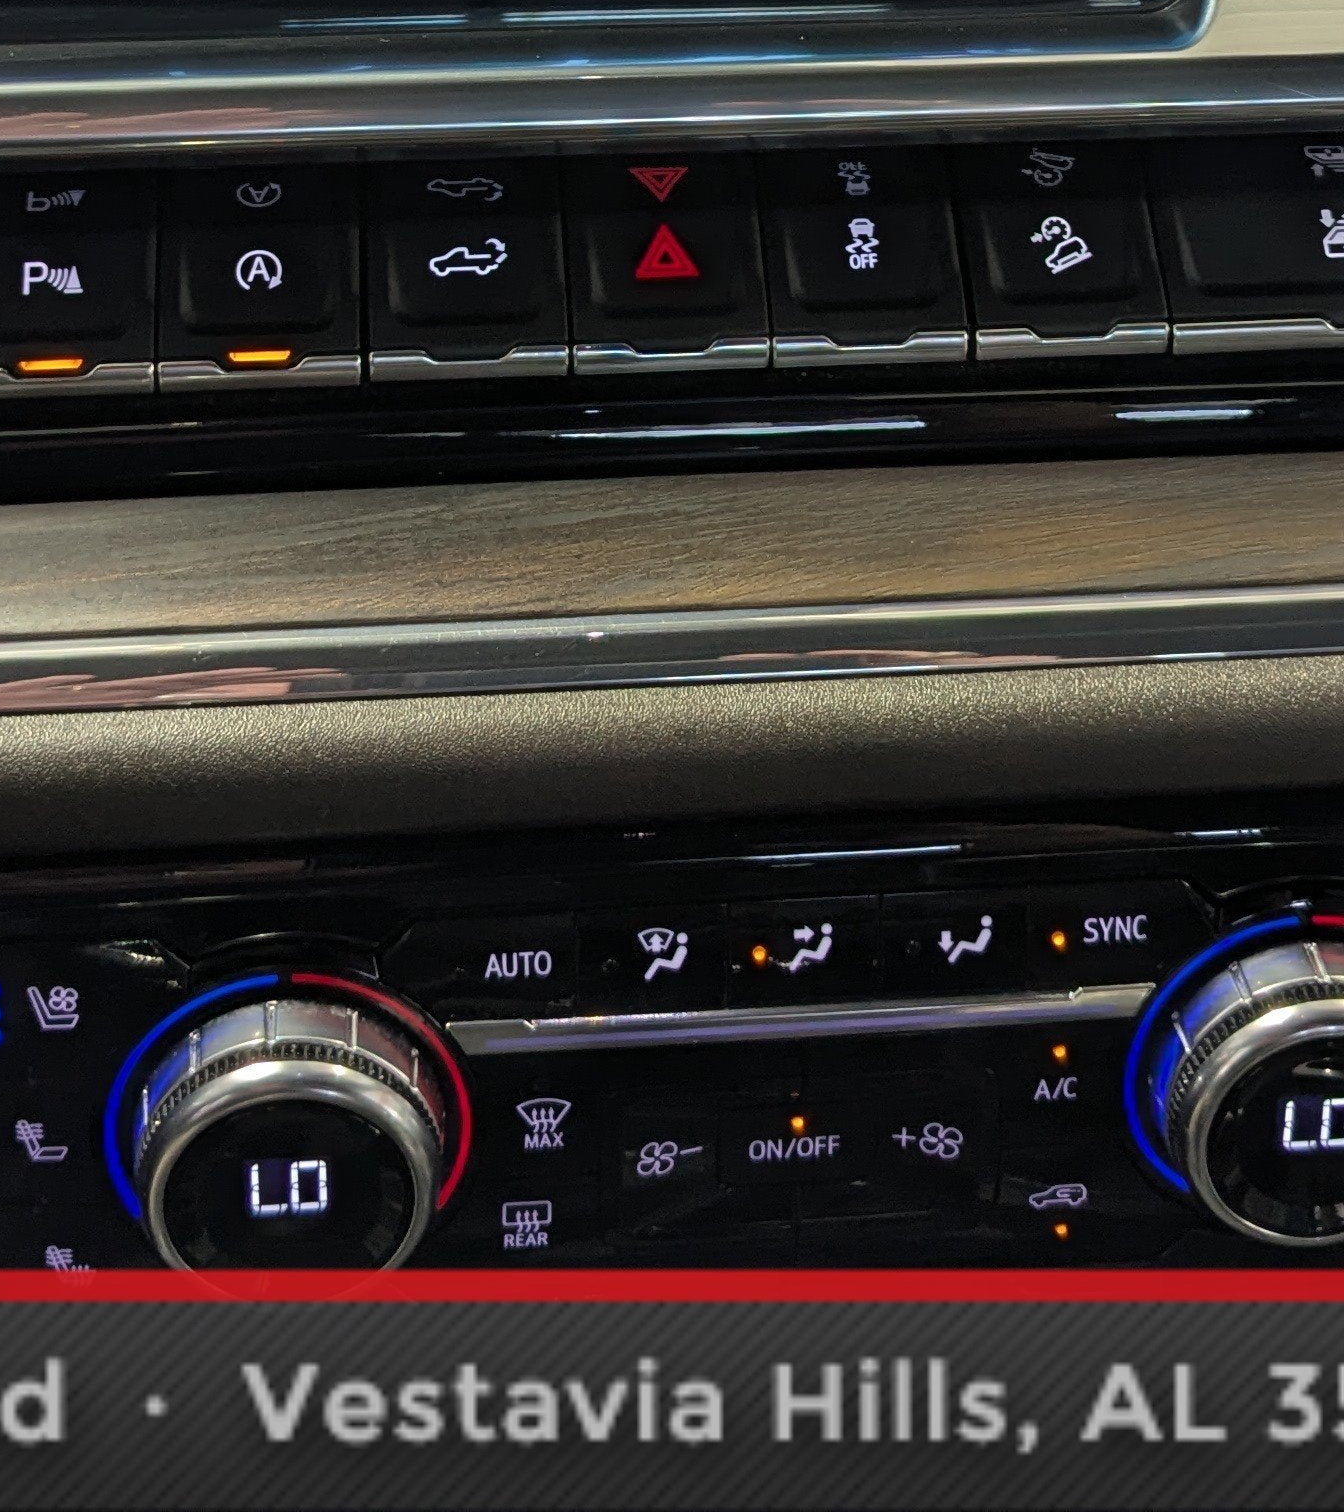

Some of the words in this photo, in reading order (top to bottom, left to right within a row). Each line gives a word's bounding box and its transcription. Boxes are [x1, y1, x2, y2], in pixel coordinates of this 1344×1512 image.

[849, 253, 878, 269] OFF
[1084, 914, 1148, 944] SYNC
[485, 951, 552, 980] AUTO
[1034, 1077, 1078, 1101] A/C
[523, 1131, 564, 1150] MAX
[748, 1134, 840, 1161] ON/OFF
[503, 1231, 549, 1249] REAR
